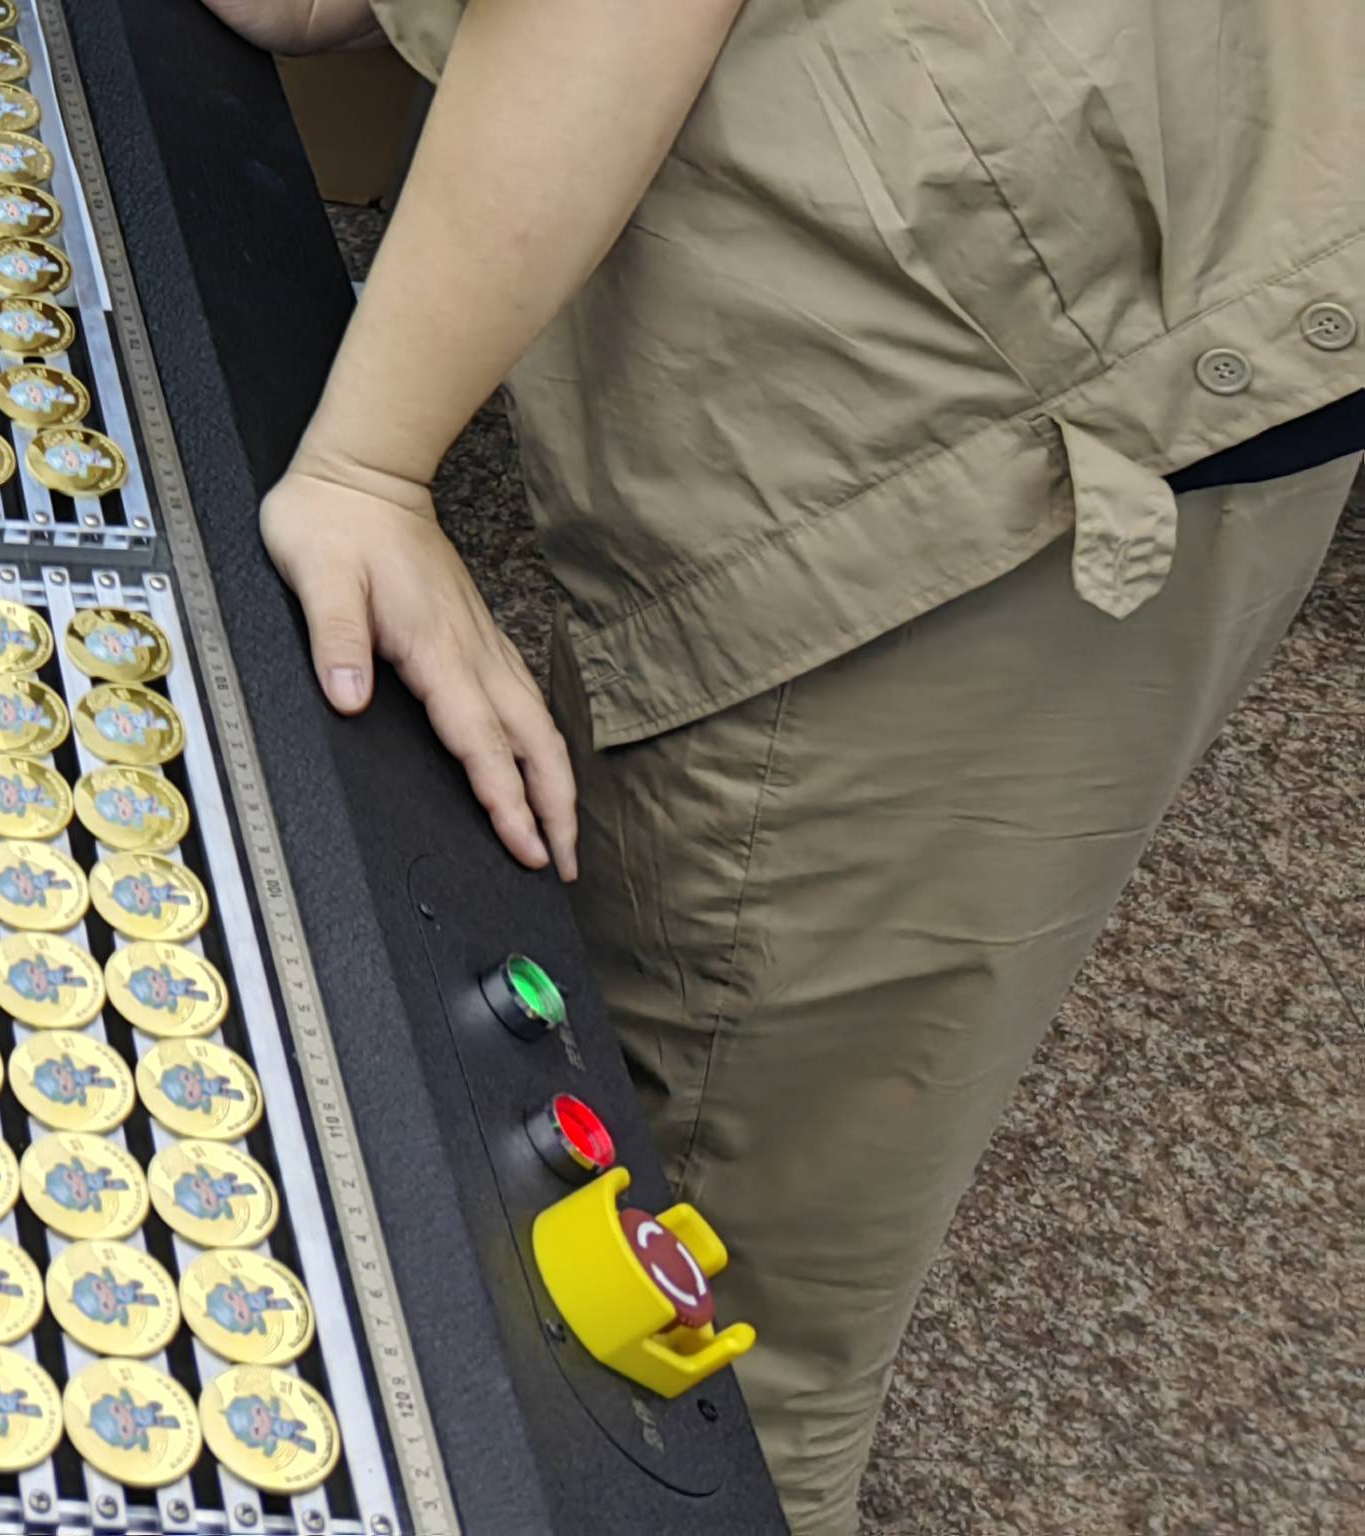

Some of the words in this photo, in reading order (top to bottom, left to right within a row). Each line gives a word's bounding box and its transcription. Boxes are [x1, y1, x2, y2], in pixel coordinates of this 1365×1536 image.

[326, 1116, 343, 1138] 110
[395, 1392, 414, 1418] 120
[415, 1467, 431, 1479] 2
